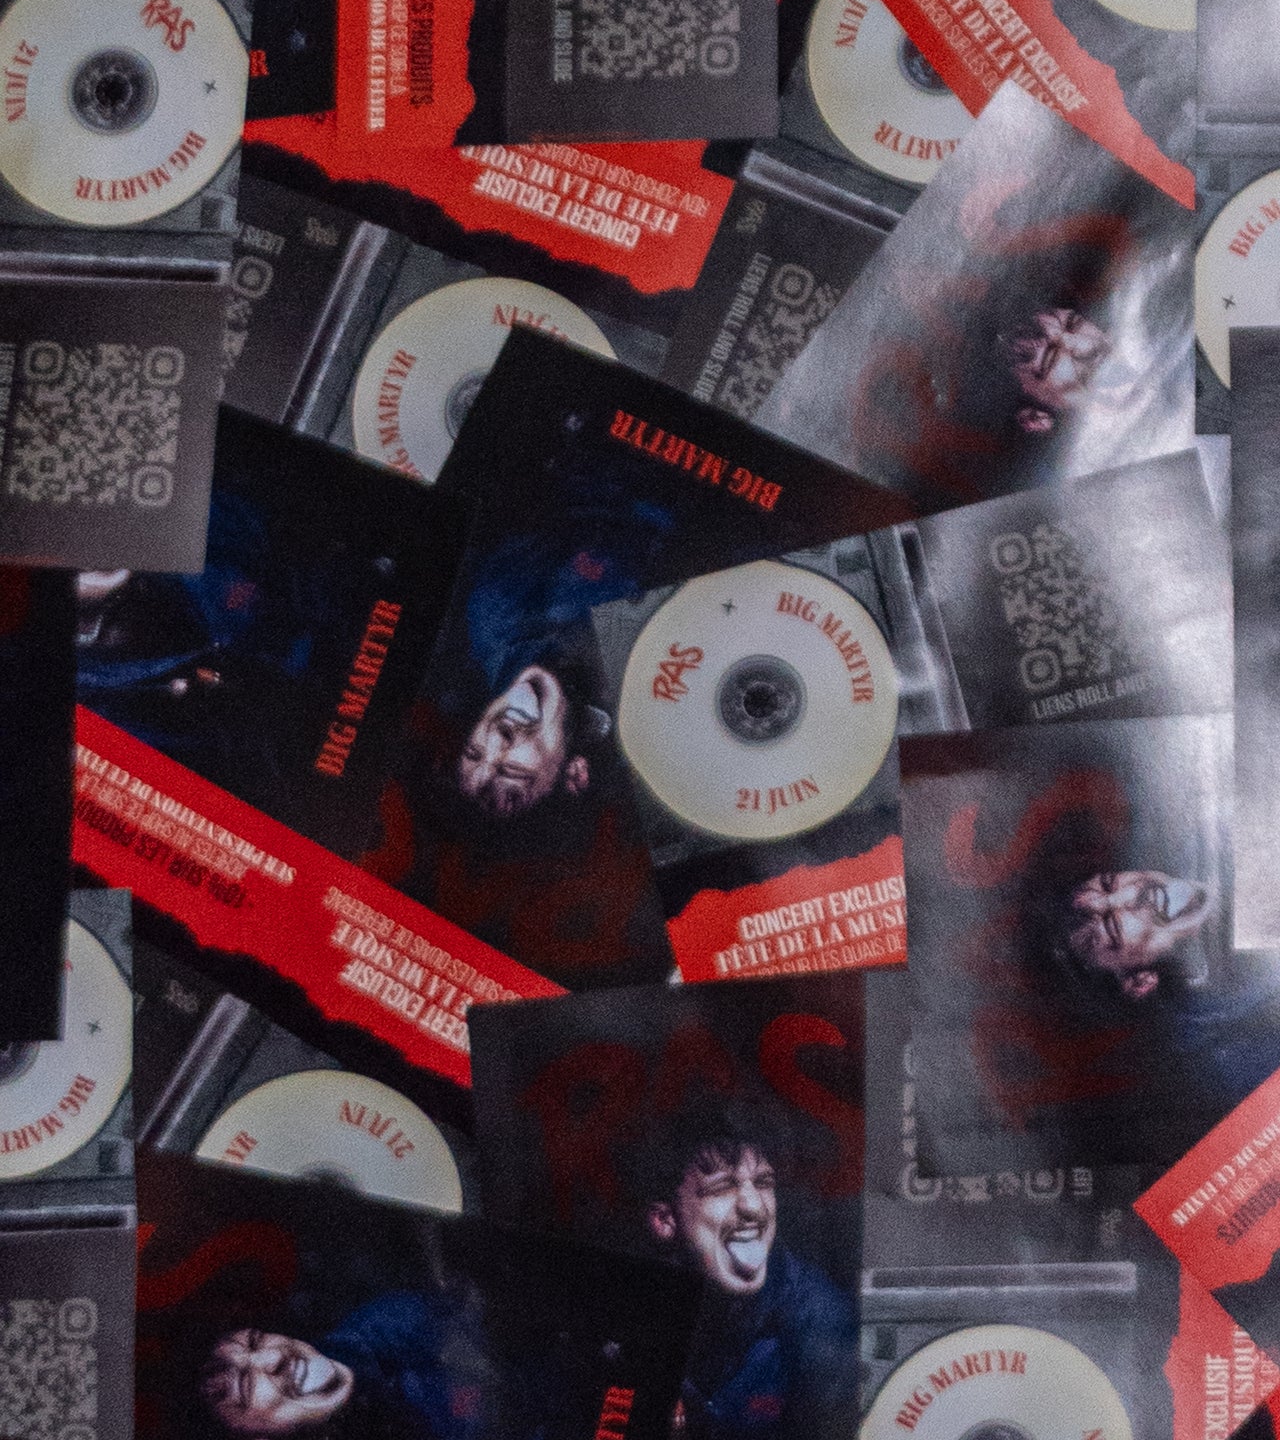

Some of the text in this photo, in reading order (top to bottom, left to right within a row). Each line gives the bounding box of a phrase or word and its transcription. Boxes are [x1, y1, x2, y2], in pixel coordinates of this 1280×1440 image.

[605, 408, 783, 511] BIG MARTYR
[313, 596, 403, 777] BIG MARTYR
[649, 643, 705, 704] RAS
[774, 591, 875, 705] BIG MARTYR
[735, 778, 820, 817] 21 JUIN
